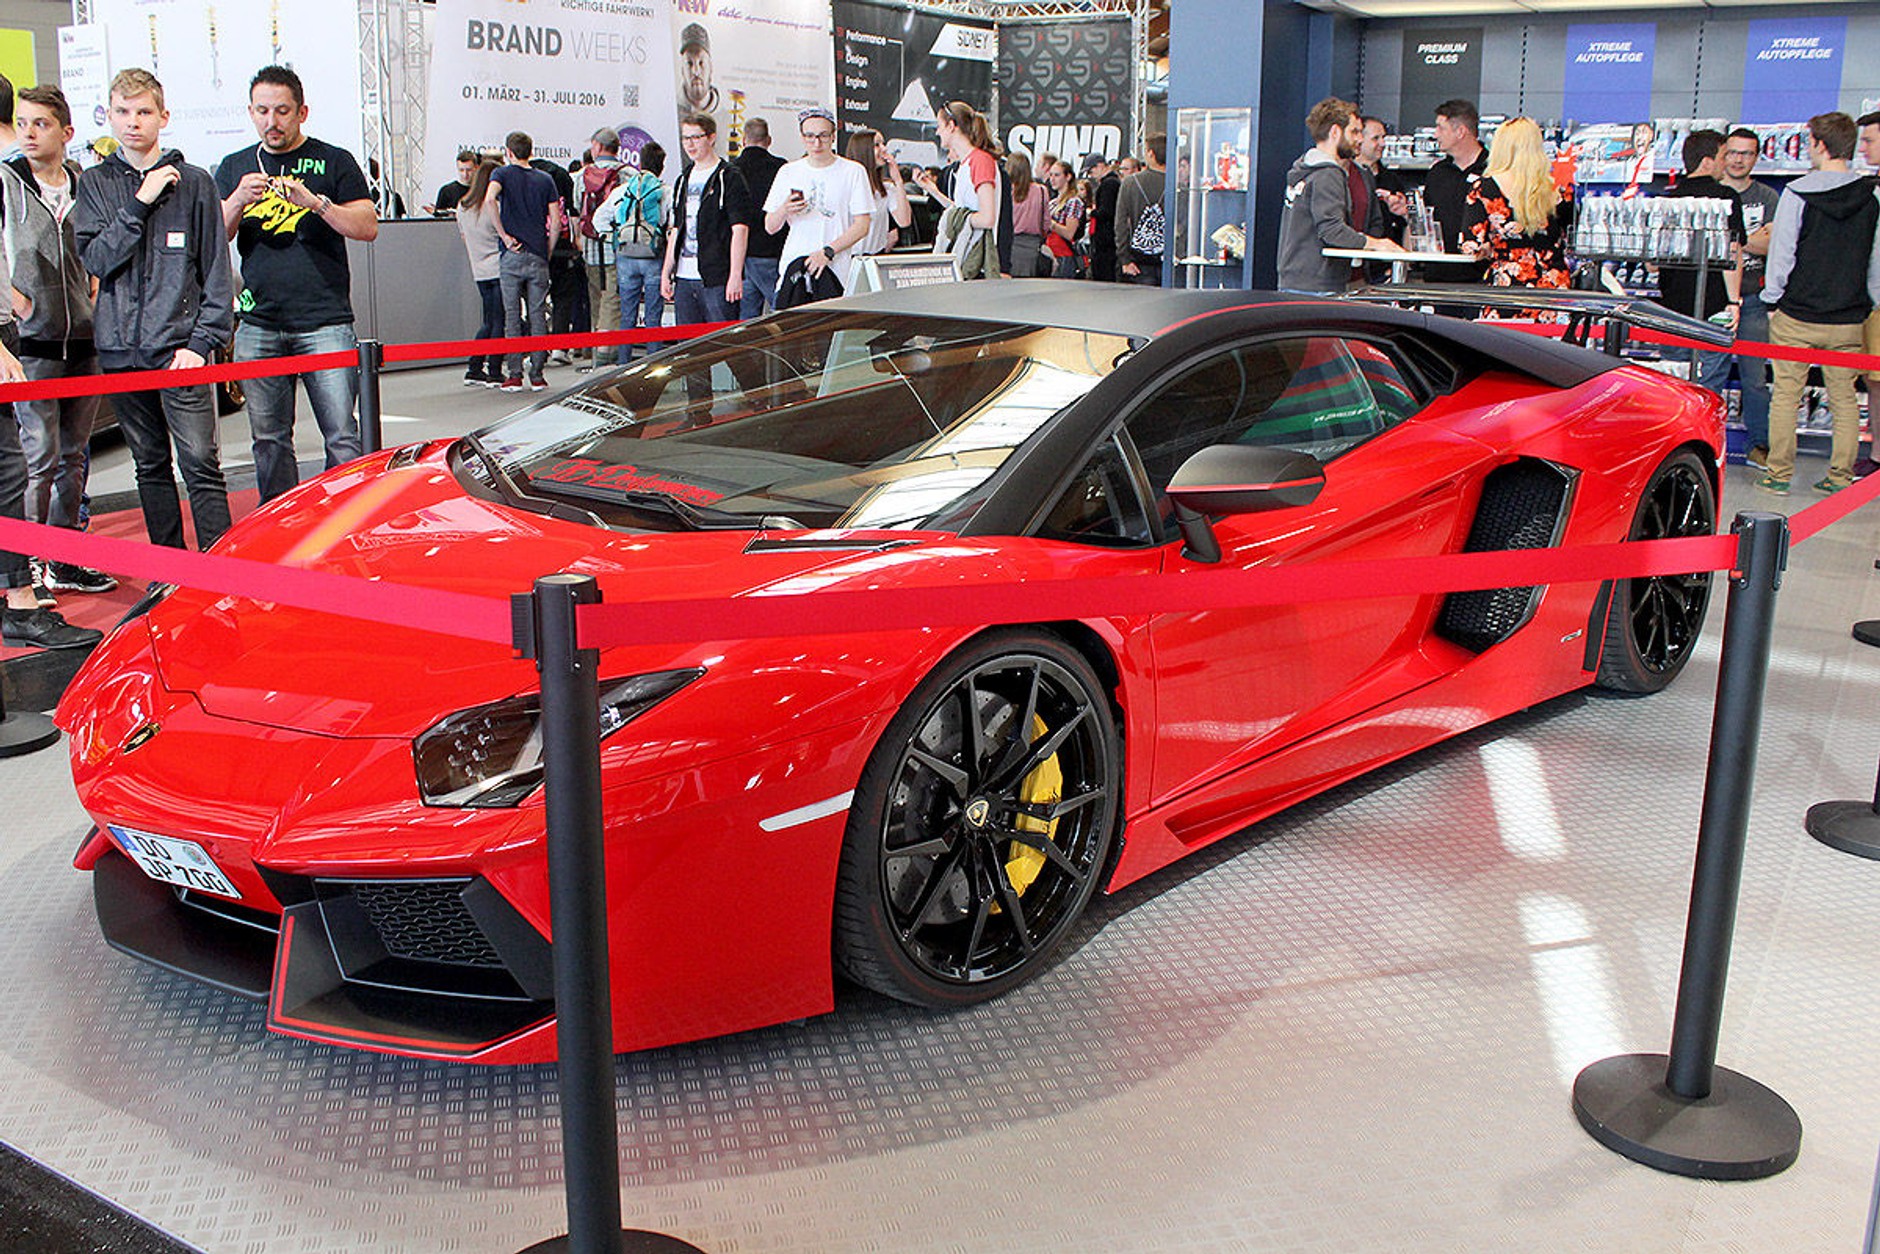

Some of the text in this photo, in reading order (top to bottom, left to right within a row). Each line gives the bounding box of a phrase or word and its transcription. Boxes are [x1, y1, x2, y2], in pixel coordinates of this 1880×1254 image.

[467, 19, 647, 65] BRAND WEEKS
[1417, 42, 1468, 53] PREMIUM
[1587, 41, 1633, 52] XTREME
[1770, 37, 1820, 49] XTREME
[846, 51, 869, 68] Design
[1424, 53, 1459, 65] CLASS
[1575, 52, 1644, 64] AUTOPFLEGE
[1756, 48, 1833, 61] AUTOPFLEGE
[462, 85, 484, 100] 01.
[487, 84, 521, 102] MÄRZ
[534, 89, 550, 105] 31.
[553, 91, 577, 106] JULI
[579, 93, 606, 107] 2016
[291, 158, 327, 176] JPN
[132, 834, 173, 861] DO
[142, 856, 172, 880] JP
